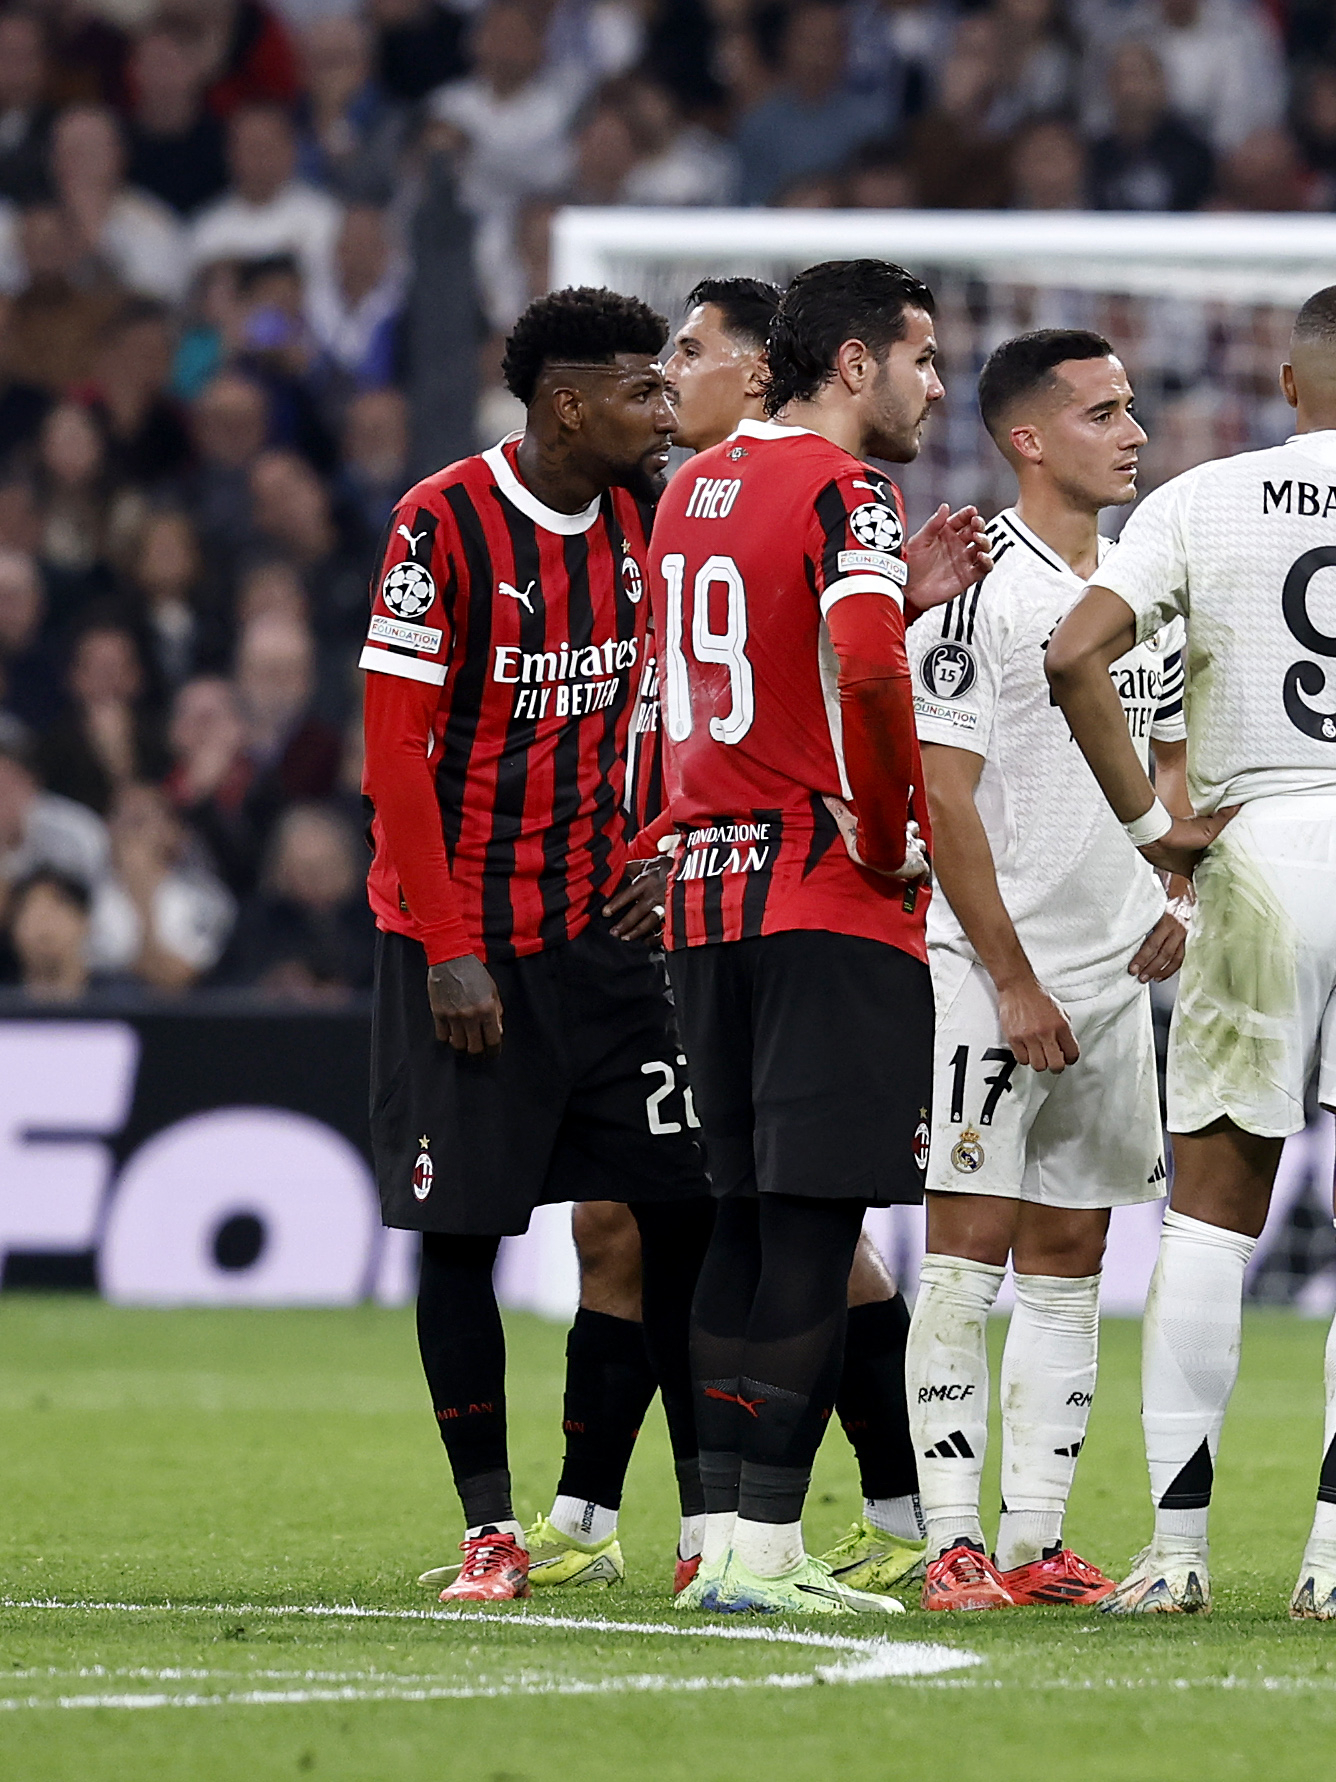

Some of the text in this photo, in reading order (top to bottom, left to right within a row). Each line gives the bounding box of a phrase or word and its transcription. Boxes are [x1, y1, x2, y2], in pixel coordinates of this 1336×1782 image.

[685, 477, 743, 518] THEO
[870, 518, 882, 536] 7
[841, 556, 906, 577] FOUNDATION
[401, 580, 414, 600] 7
[372, 623, 439, 646] FOUNDATION
[493, 637, 639, 683] Emirates
[661, 553, 755, 745] 19
[939, 668, 956, 683] 15
[514, 687, 551, 719] FLY
[556, 678, 620, 717] BETTER
[913, 702, 977, 725] OUNDATION
[686, 822, 771, 847] FONDAZIONE
[676, 845, 770, 881] MILAN
[949, 1045, 1018, 1125] 17
[918, 1384, 976, 1404] RMCF
[1066, 1391, 1093, 1407] RM
